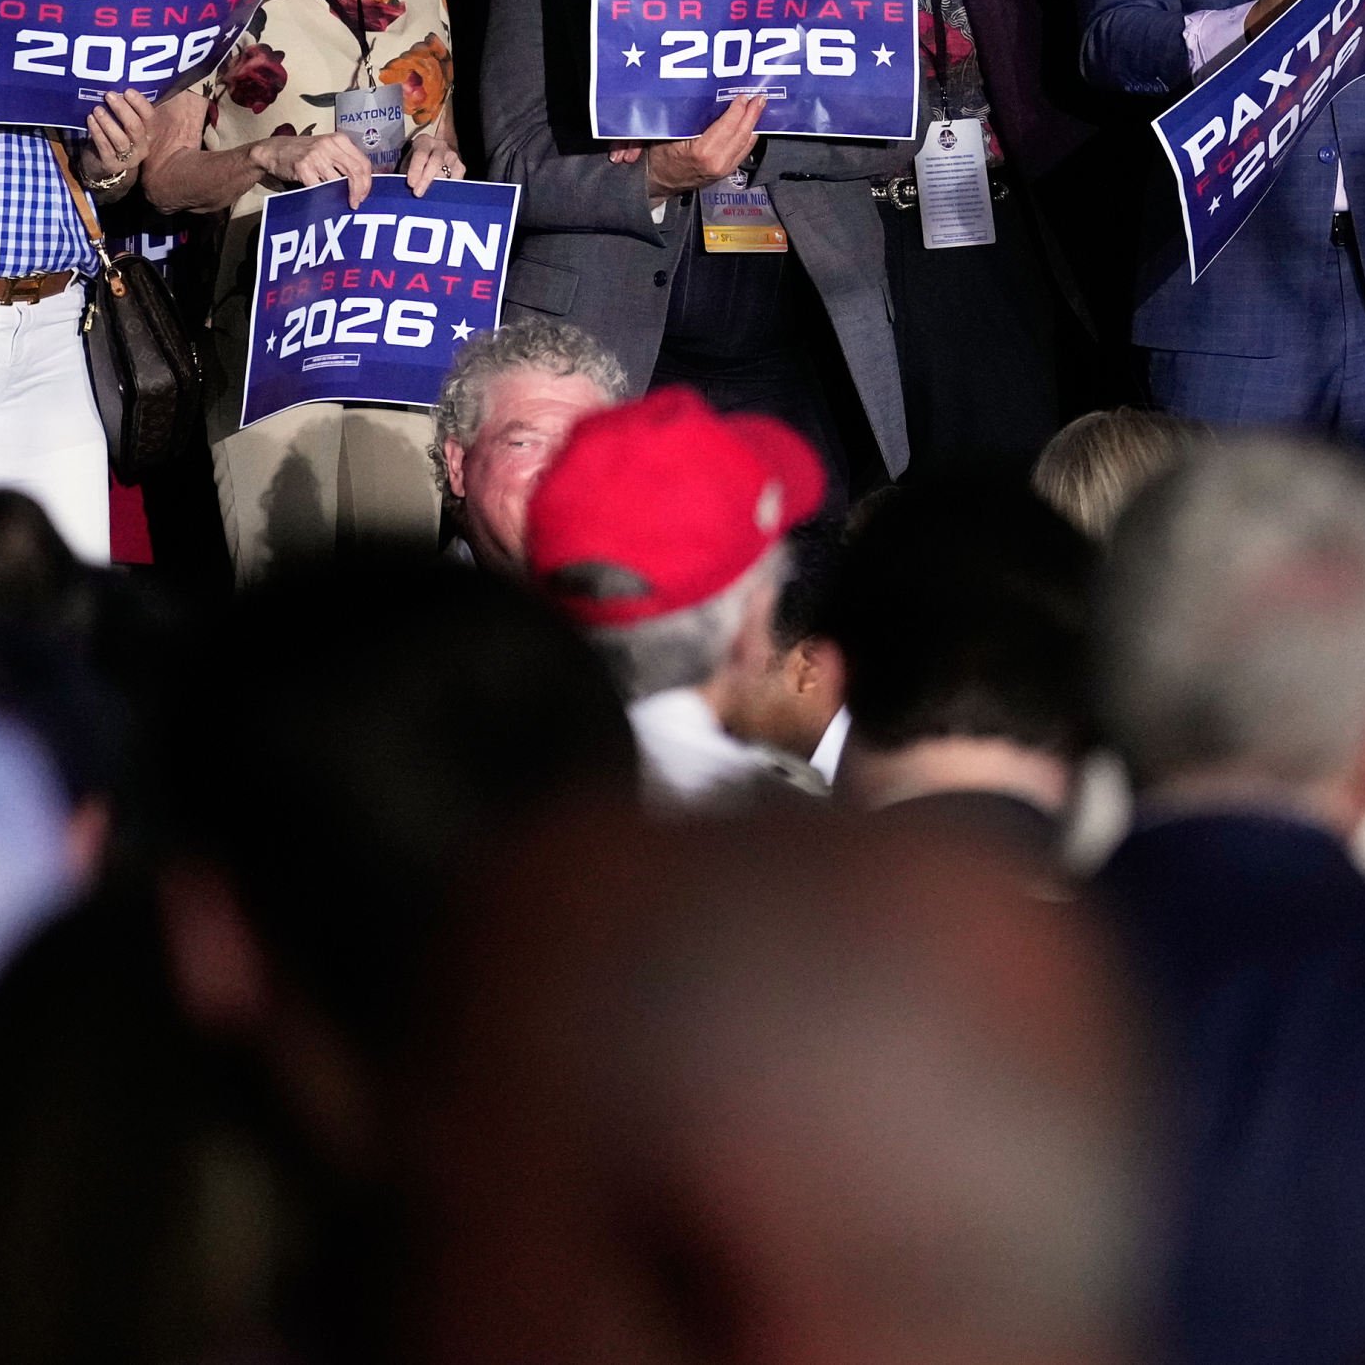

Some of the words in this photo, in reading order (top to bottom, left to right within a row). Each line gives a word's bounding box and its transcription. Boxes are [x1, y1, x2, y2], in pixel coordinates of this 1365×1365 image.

[611, 0, 702, 21] FOR
[730, 0, 905, 22] SENATE
[13, 25, 221, 83] 2026
[659, 27, 856, 79] 2026
[340, 108, 387, 124] PAXTON
[387, 105, 402, 121] 26
[1232, 26, 1363, 199] 2026
[1195, 126, 1261, 197] FOR
[269, 213, 503, 282] PAXTON
[266, 278, 312, 310] FOR
[321, 269, 494, 300] SENATE
[279, 297, 438, 359] 2026
